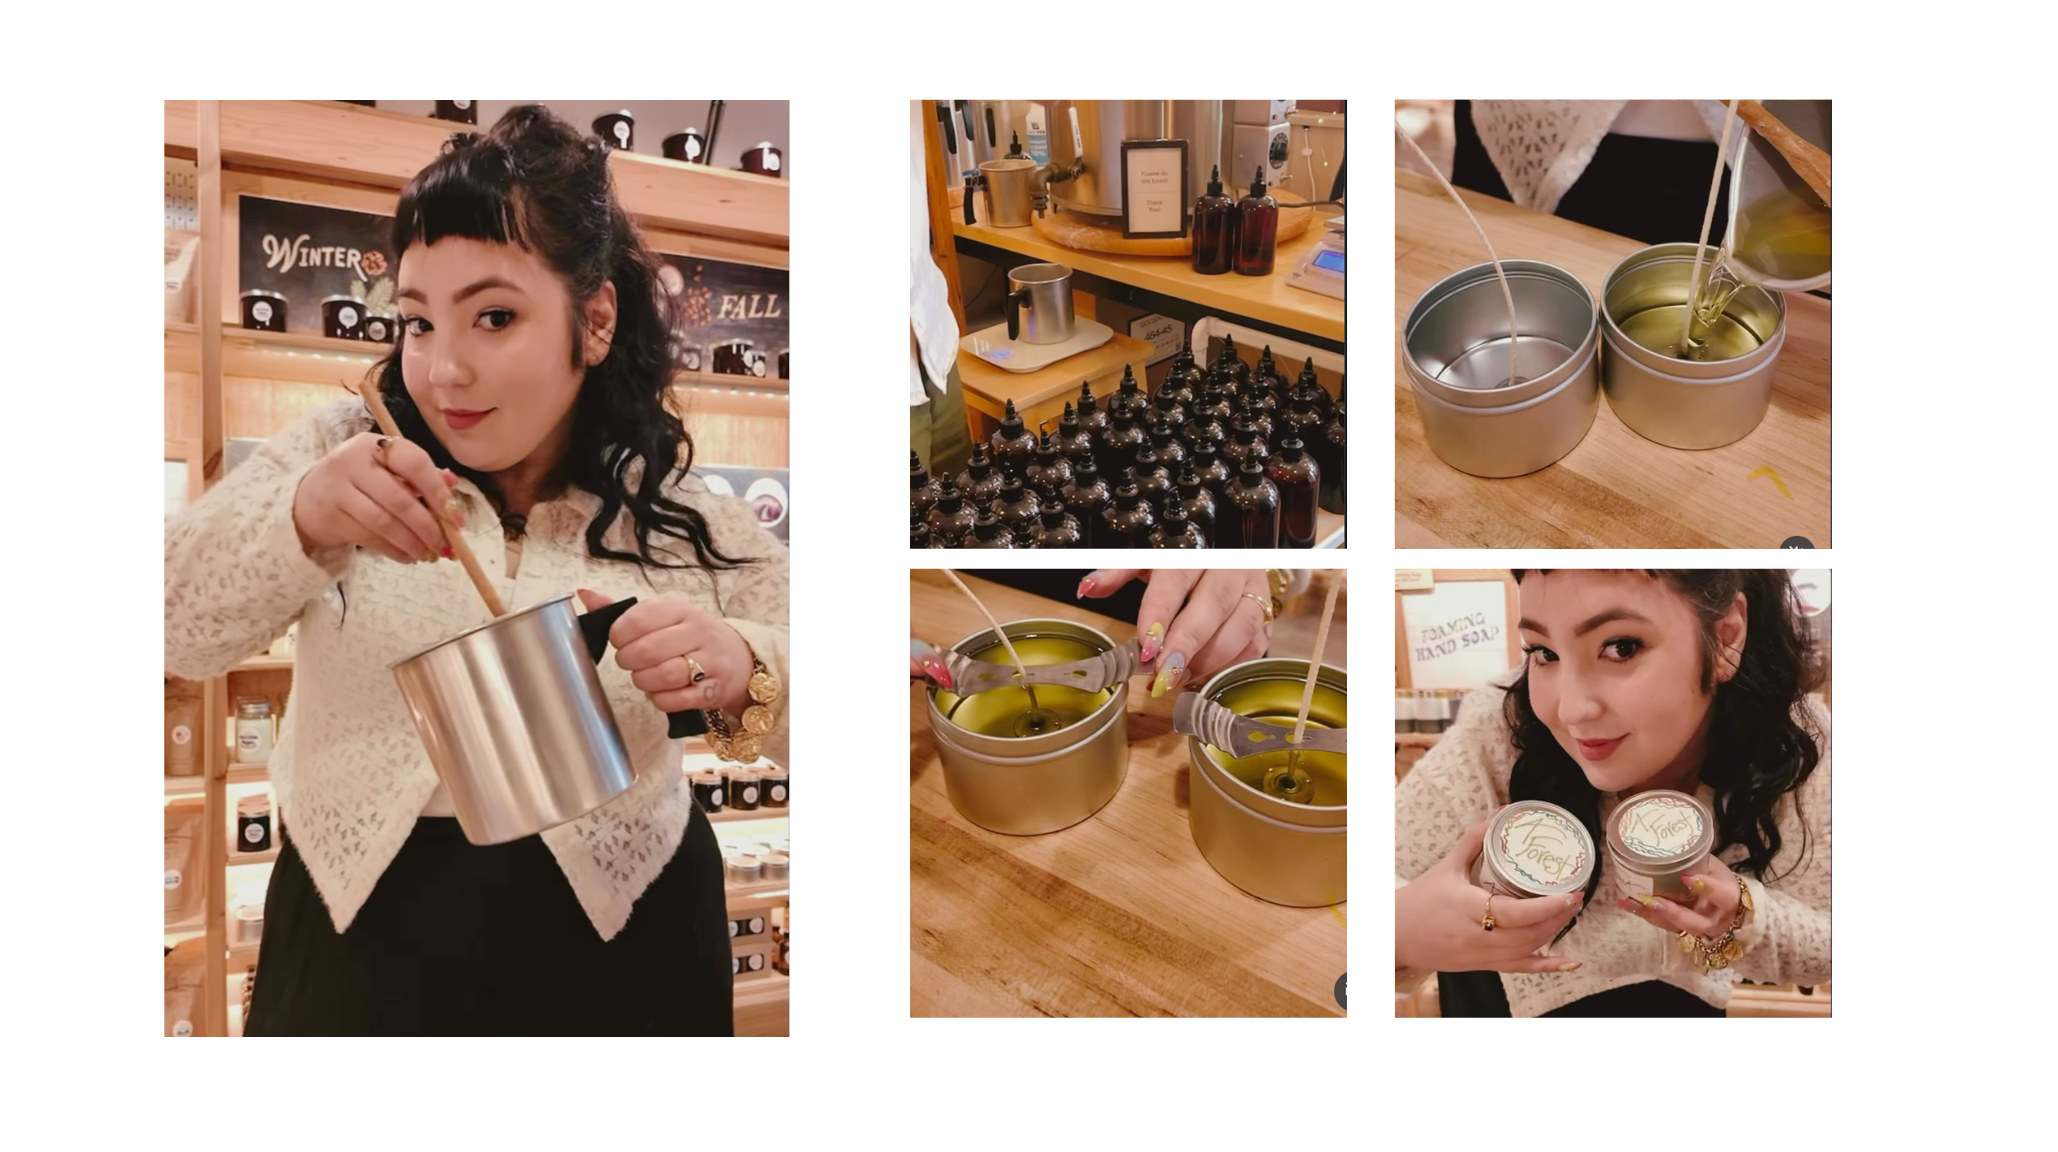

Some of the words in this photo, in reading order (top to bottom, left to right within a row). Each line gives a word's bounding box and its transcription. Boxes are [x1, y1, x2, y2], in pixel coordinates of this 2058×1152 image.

[717, 293, 782, 320] FALL
[1144, 324, 1172, 341] 464-45
[1416, 639, 1457, 662] HAND
[1461, 626, 1500, 648] SOAP
[1421, 612, 1486, 643] FOAMING
[1650, 810, 1694, 847] Forest
[1515, 836, 1576, 880] Forest
